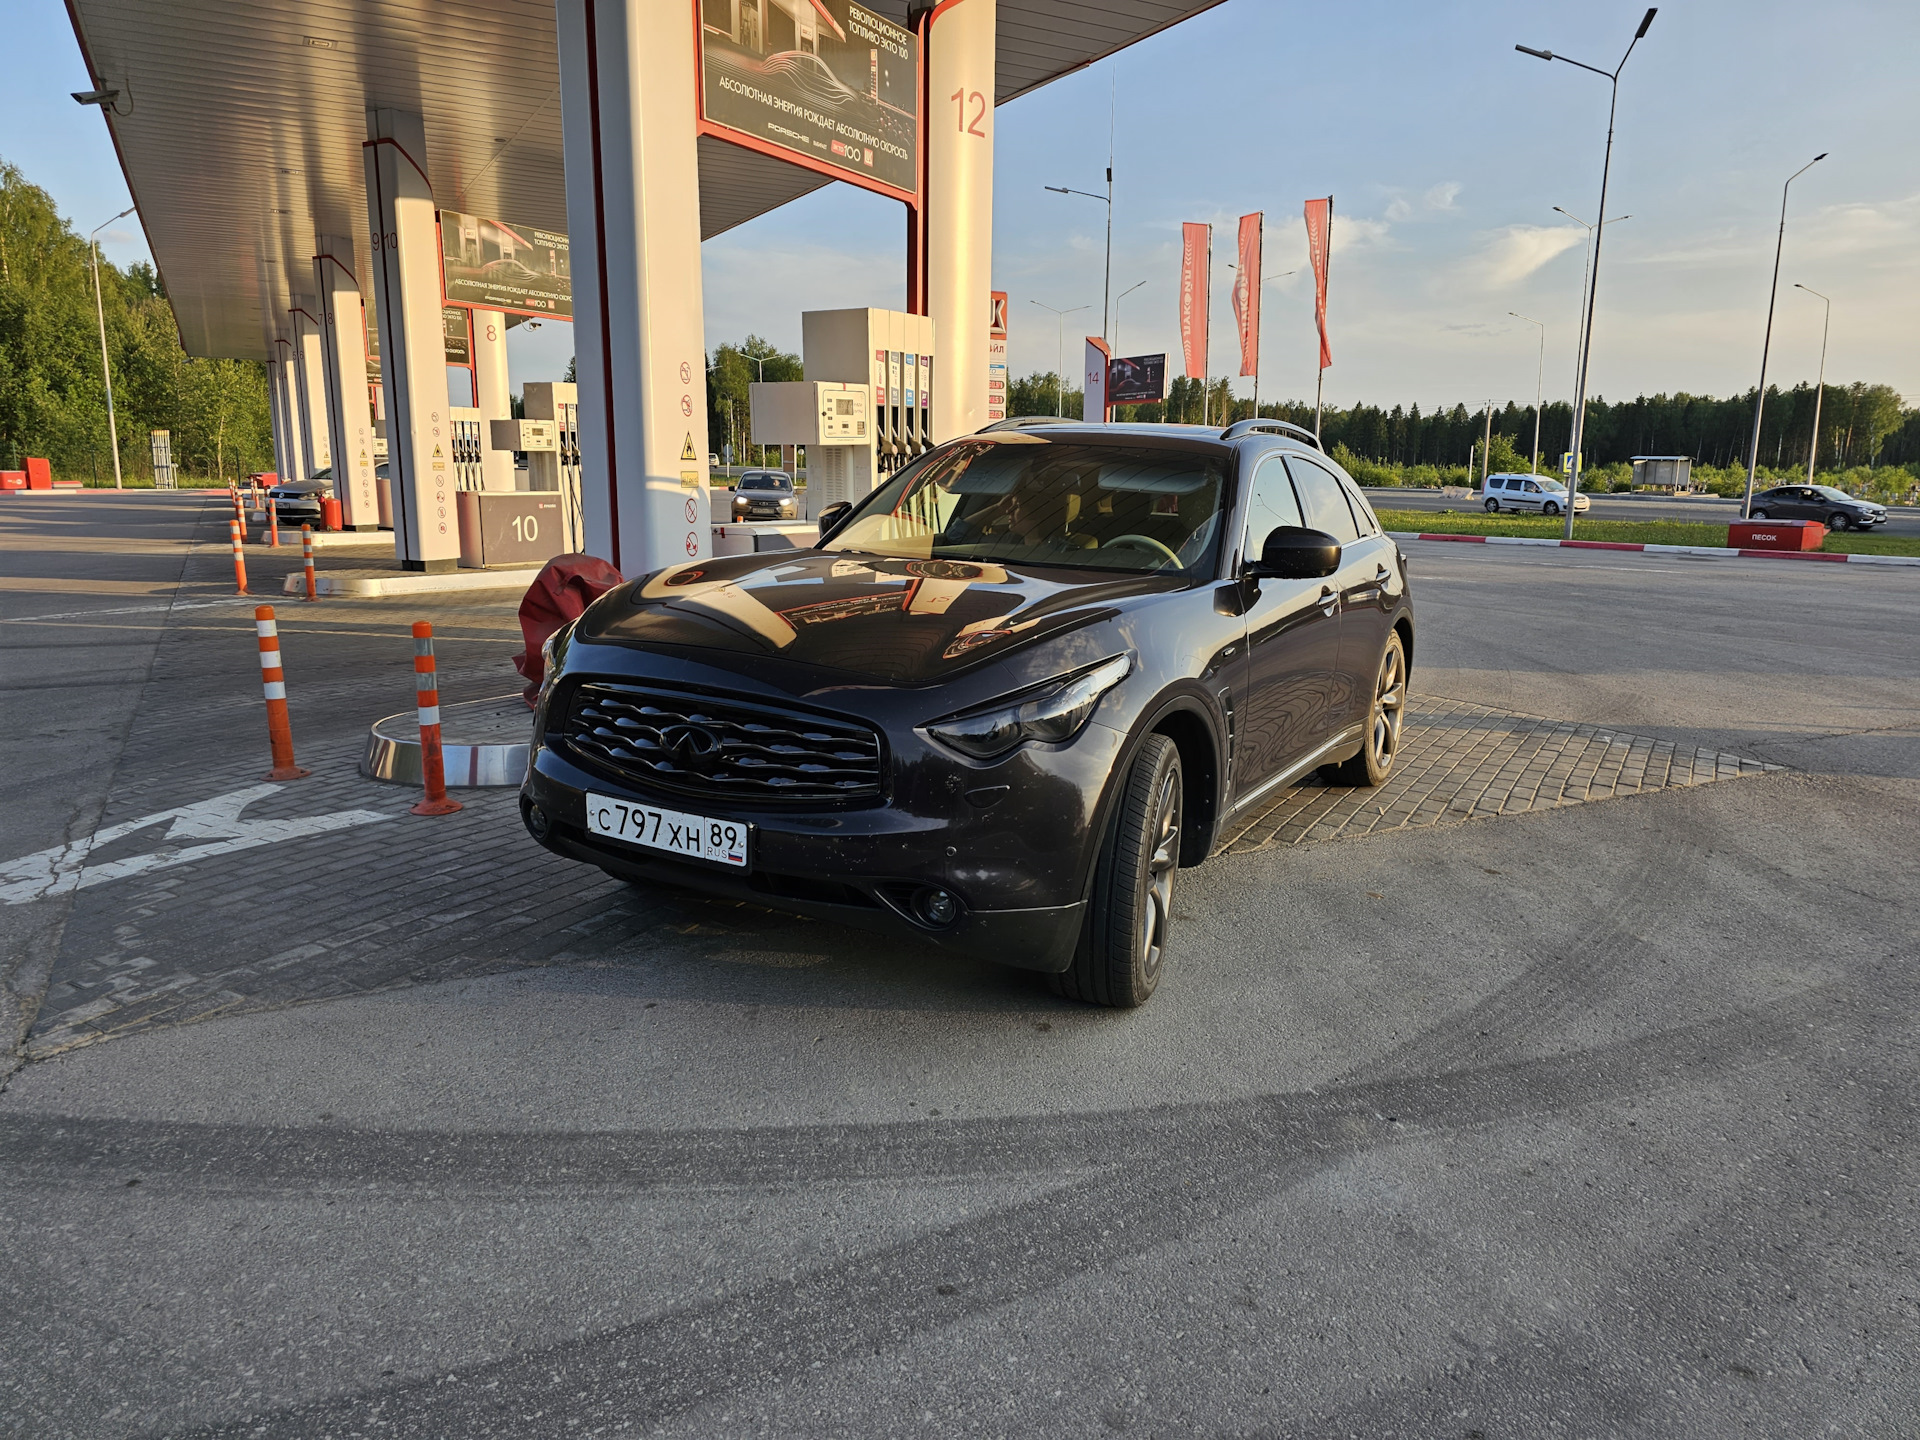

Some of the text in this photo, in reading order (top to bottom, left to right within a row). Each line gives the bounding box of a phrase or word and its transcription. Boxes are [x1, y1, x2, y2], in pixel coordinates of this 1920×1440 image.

[849, 6, 907, 45] РЕВОЛЮЦИОННОЕ
[848, 20, 908, 60] ТОПЛИВО ЭКТО 100
[719, 76, 773, 106] АБСОЛЮТНАЯ
[773, 96, 802, 118] ЭНЕРГИЯ
[804, 109, 836, 131] РОЖДАЕТ
[836, 122, 879, 148] АБСОЛЮТНУЮ
[880, 140, 908, 160] СКОРОСТЬ
[951, 87, 986, 138] 12
[767, 122, 810, 143] PORSCHE
[844, 144, 861, 162] 100
[372, 232, 379, 251] 9
[384, 232, 398, 250] 10
[455, 278, 487, 288] АБСОЛЮТНАЯ
[1183, 270, 1192, 336] ЛУКОЙЛ
[318, 313, 323, 326] 7
[327, 312, 334, 325] 8
[486, 324, 497, 342] 8
[1087, 372, 1099, 384] 14
[511, 515, 538, 542] 10
[1751, 533, 1777, 541] ПЕСОК
[598, 804, 701, 852] С797ХН
[710, 823, 737, 850] 89
[706, 846, 727, 859] RUS
